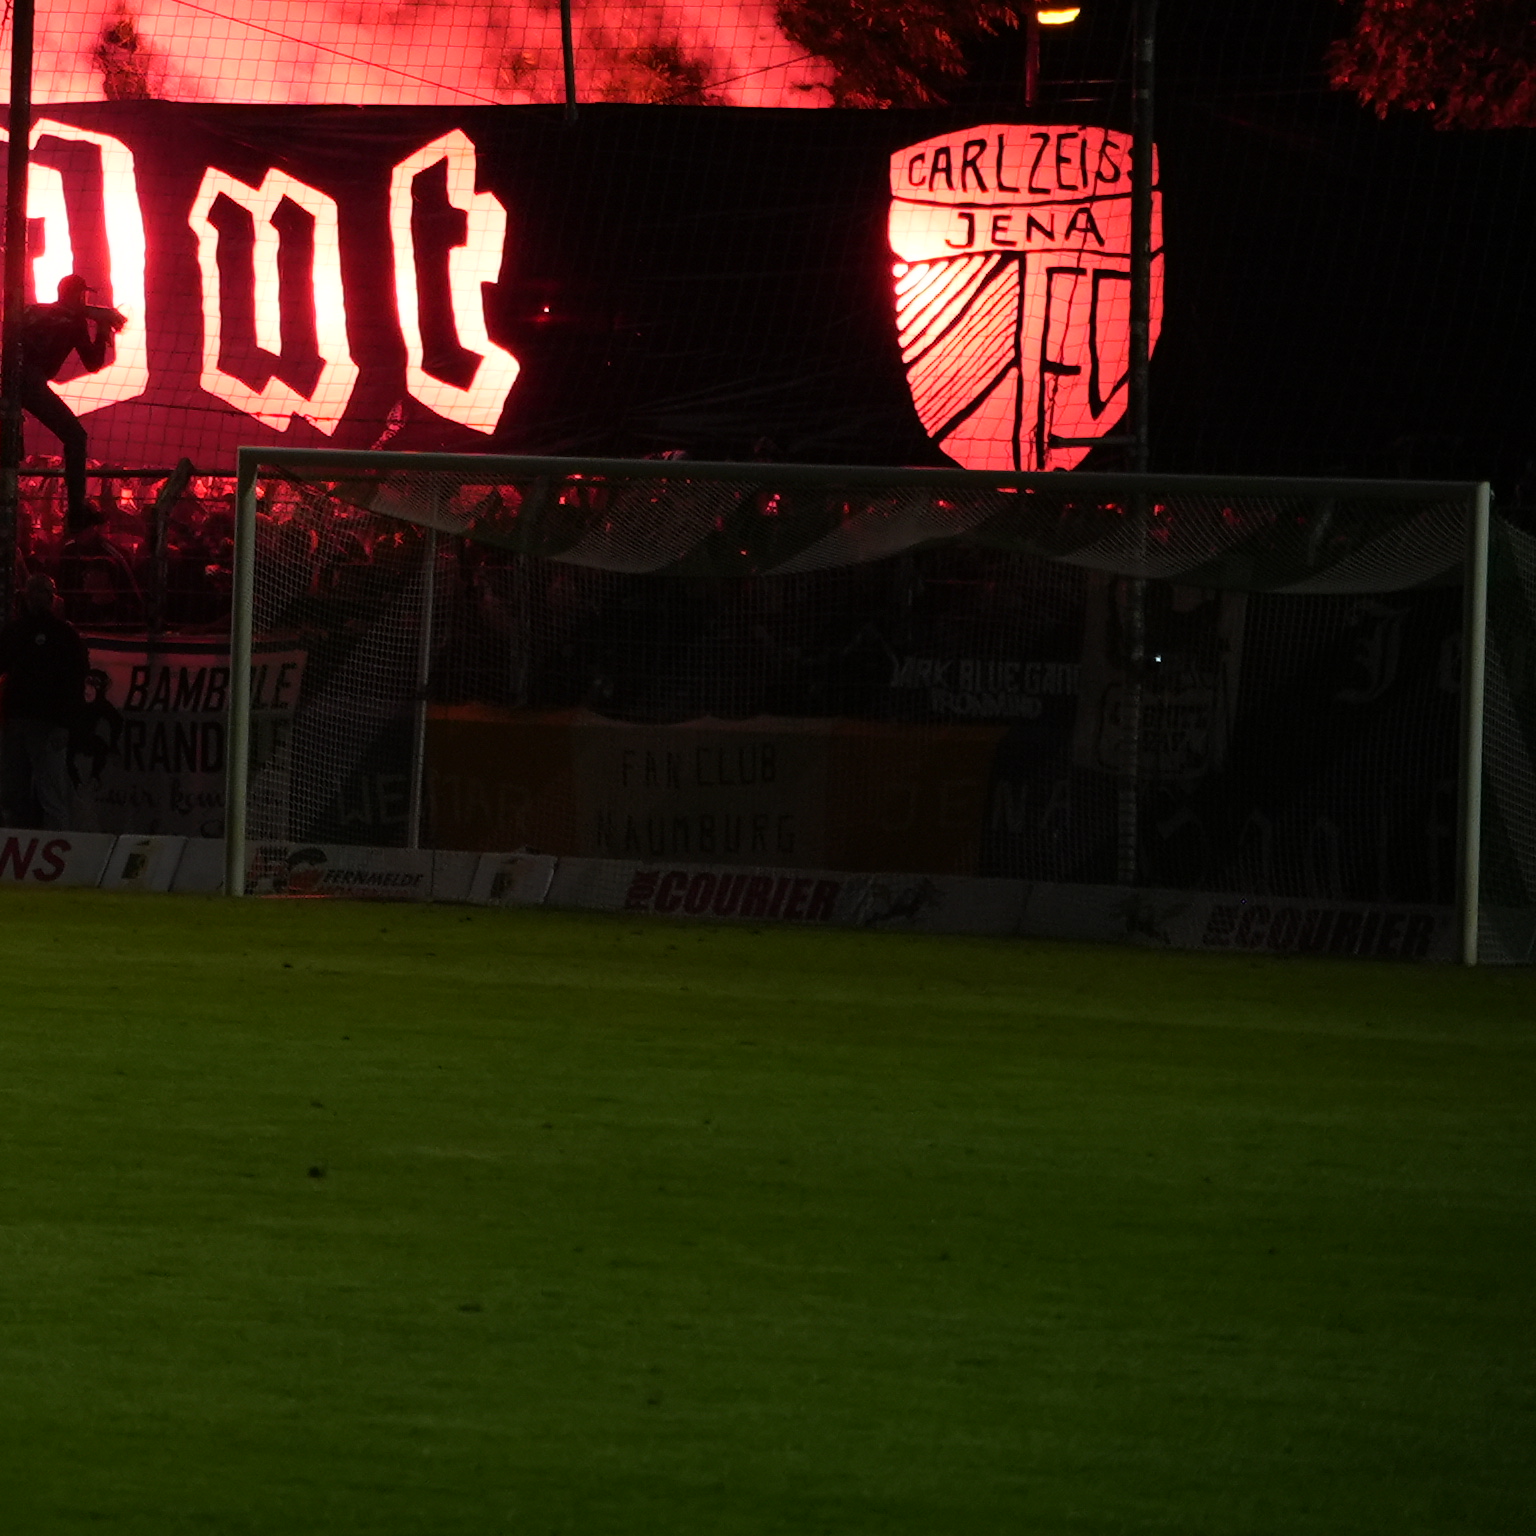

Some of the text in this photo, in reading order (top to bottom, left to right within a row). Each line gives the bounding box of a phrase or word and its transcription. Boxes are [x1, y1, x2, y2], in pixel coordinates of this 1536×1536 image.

[944, 207, 1105, 249] JENA
[128, 662, 298, 714] BAMBLE
[958, 658, 1022, 693] BLUE
[695, 742, 777, 787] CLUB
[335, 766, 532, 837] WEMAR
[596, 810, 796, 856] NAUMBURG
[654, 871, 842, 922] COURIER
[1234, 904, 1435, 958] COURIER
